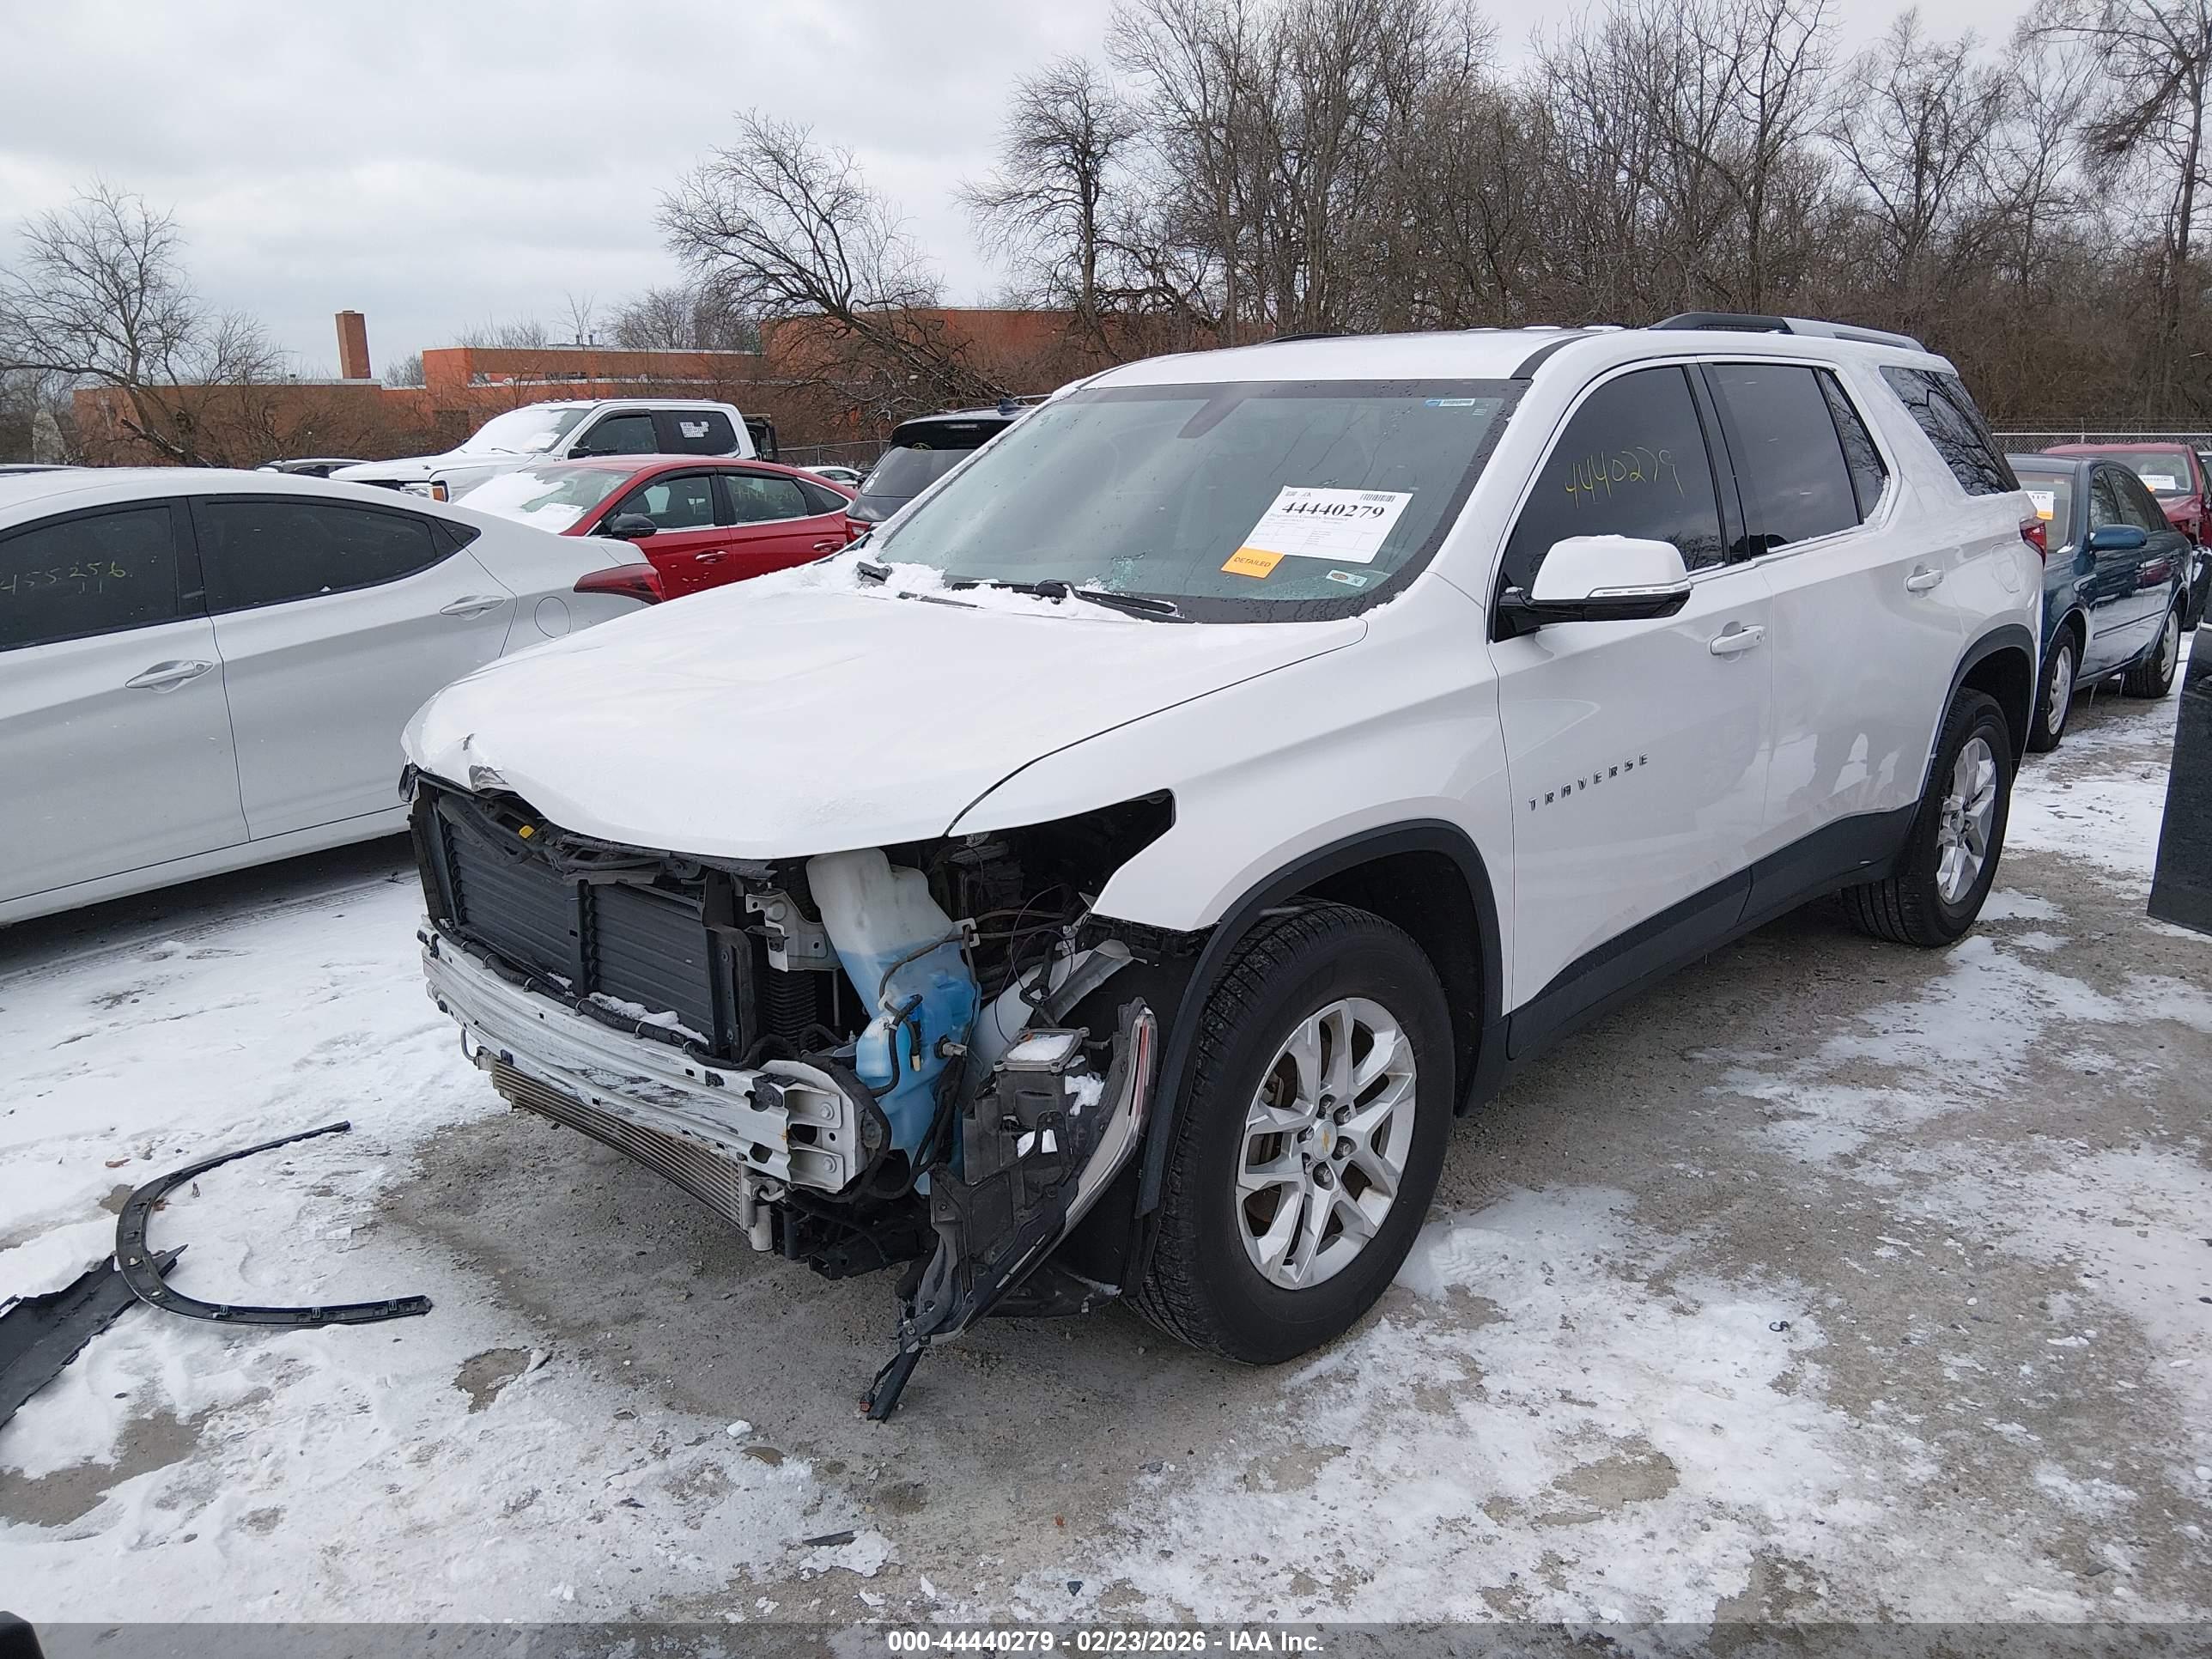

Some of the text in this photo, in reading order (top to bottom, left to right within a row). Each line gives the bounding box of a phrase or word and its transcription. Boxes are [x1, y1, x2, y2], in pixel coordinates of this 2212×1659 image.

[1565, 447, 1685, 508] 4440279
[1282, 501, 1385, 520] 44440279
[1234, 556, 1272, 568] DETAILED
[1528, 752, 1648, 811] TRAVERSE
